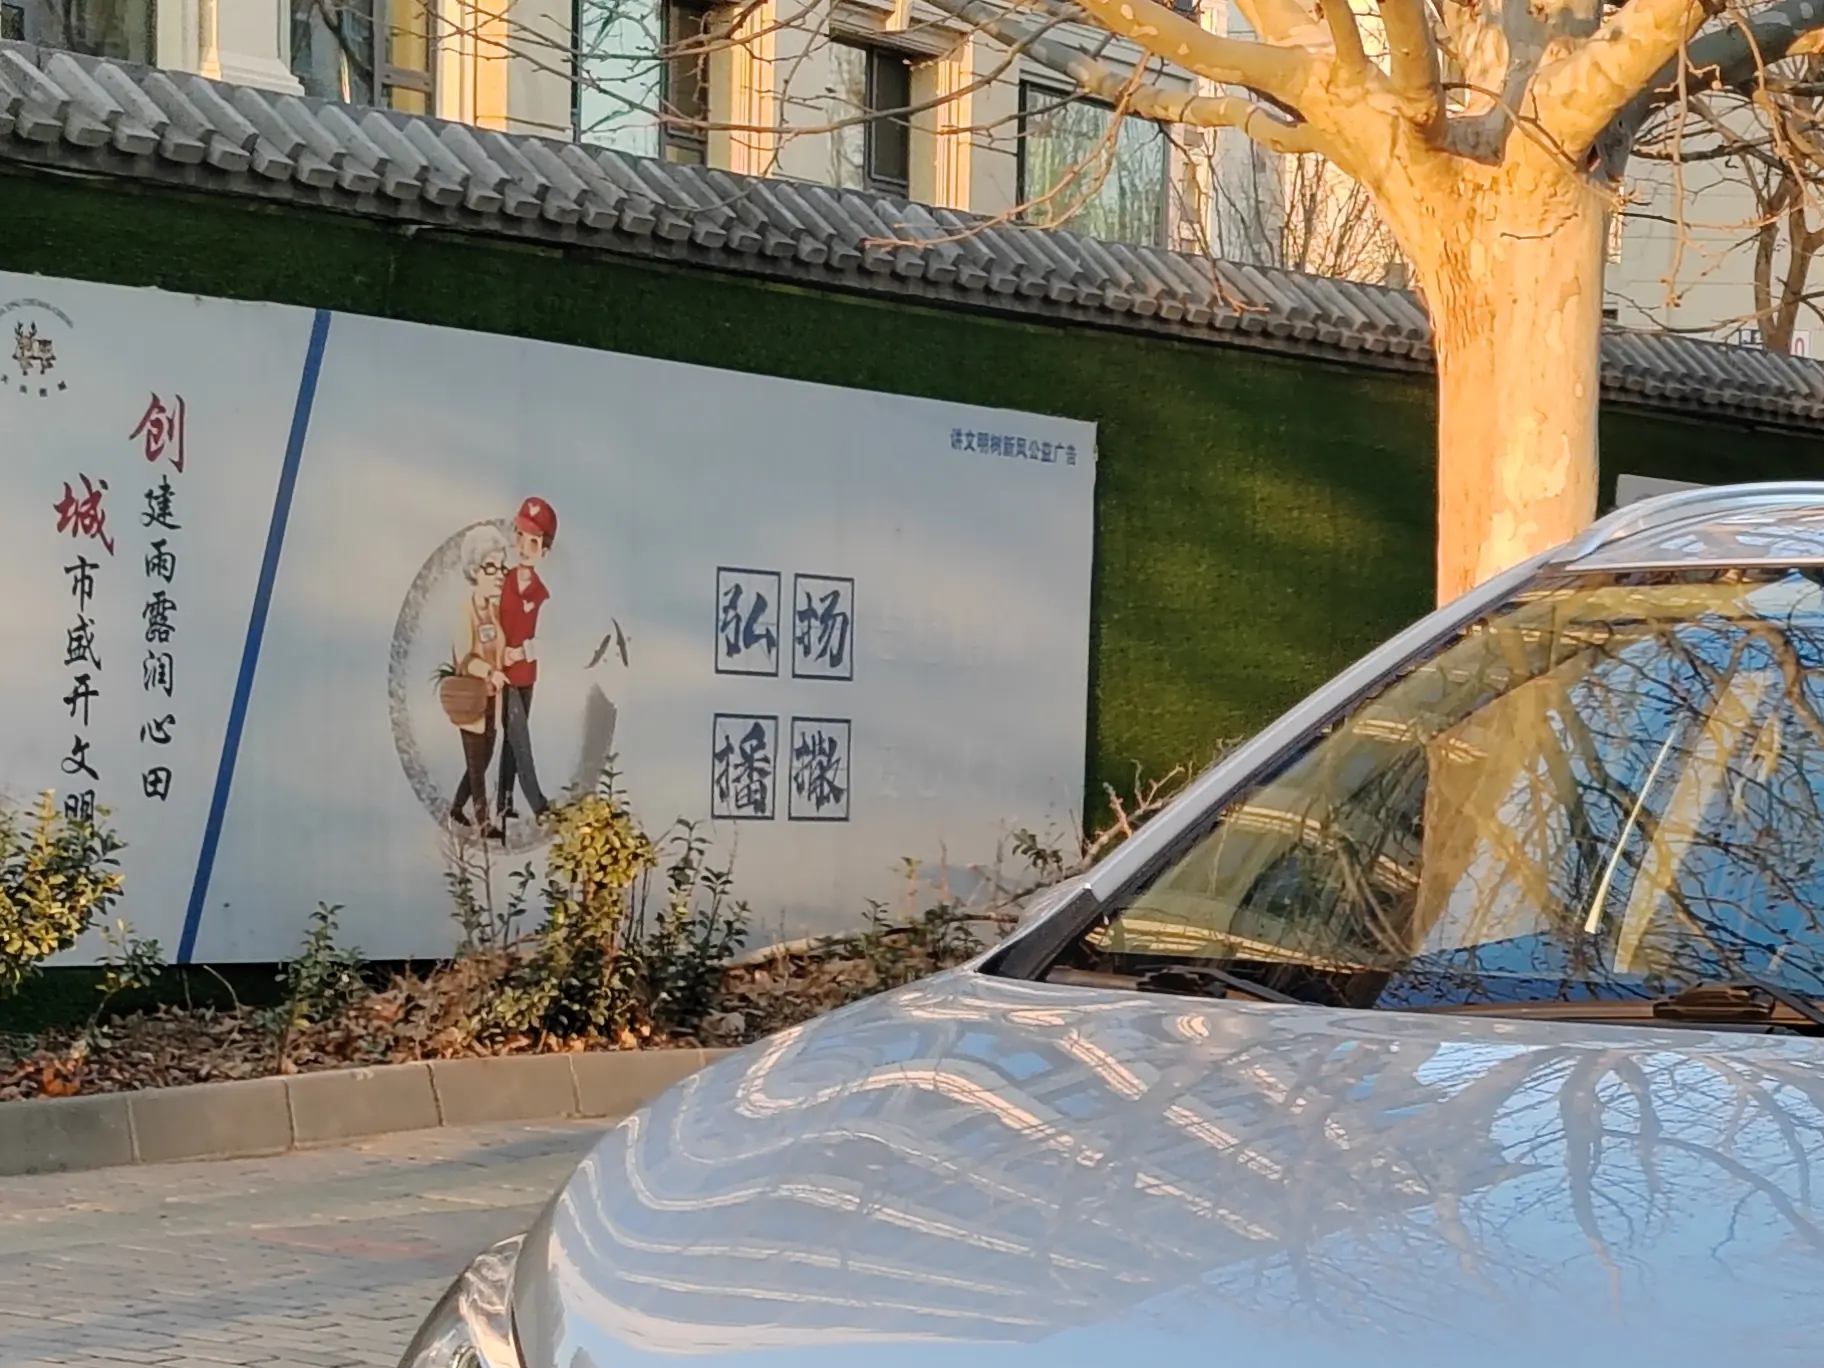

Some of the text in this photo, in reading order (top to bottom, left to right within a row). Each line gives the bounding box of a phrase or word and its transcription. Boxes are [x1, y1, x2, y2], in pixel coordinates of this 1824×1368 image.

[129, 392, 187, 801] 创建雨露润心田
[720, 583, 849, 668] 弘扬
